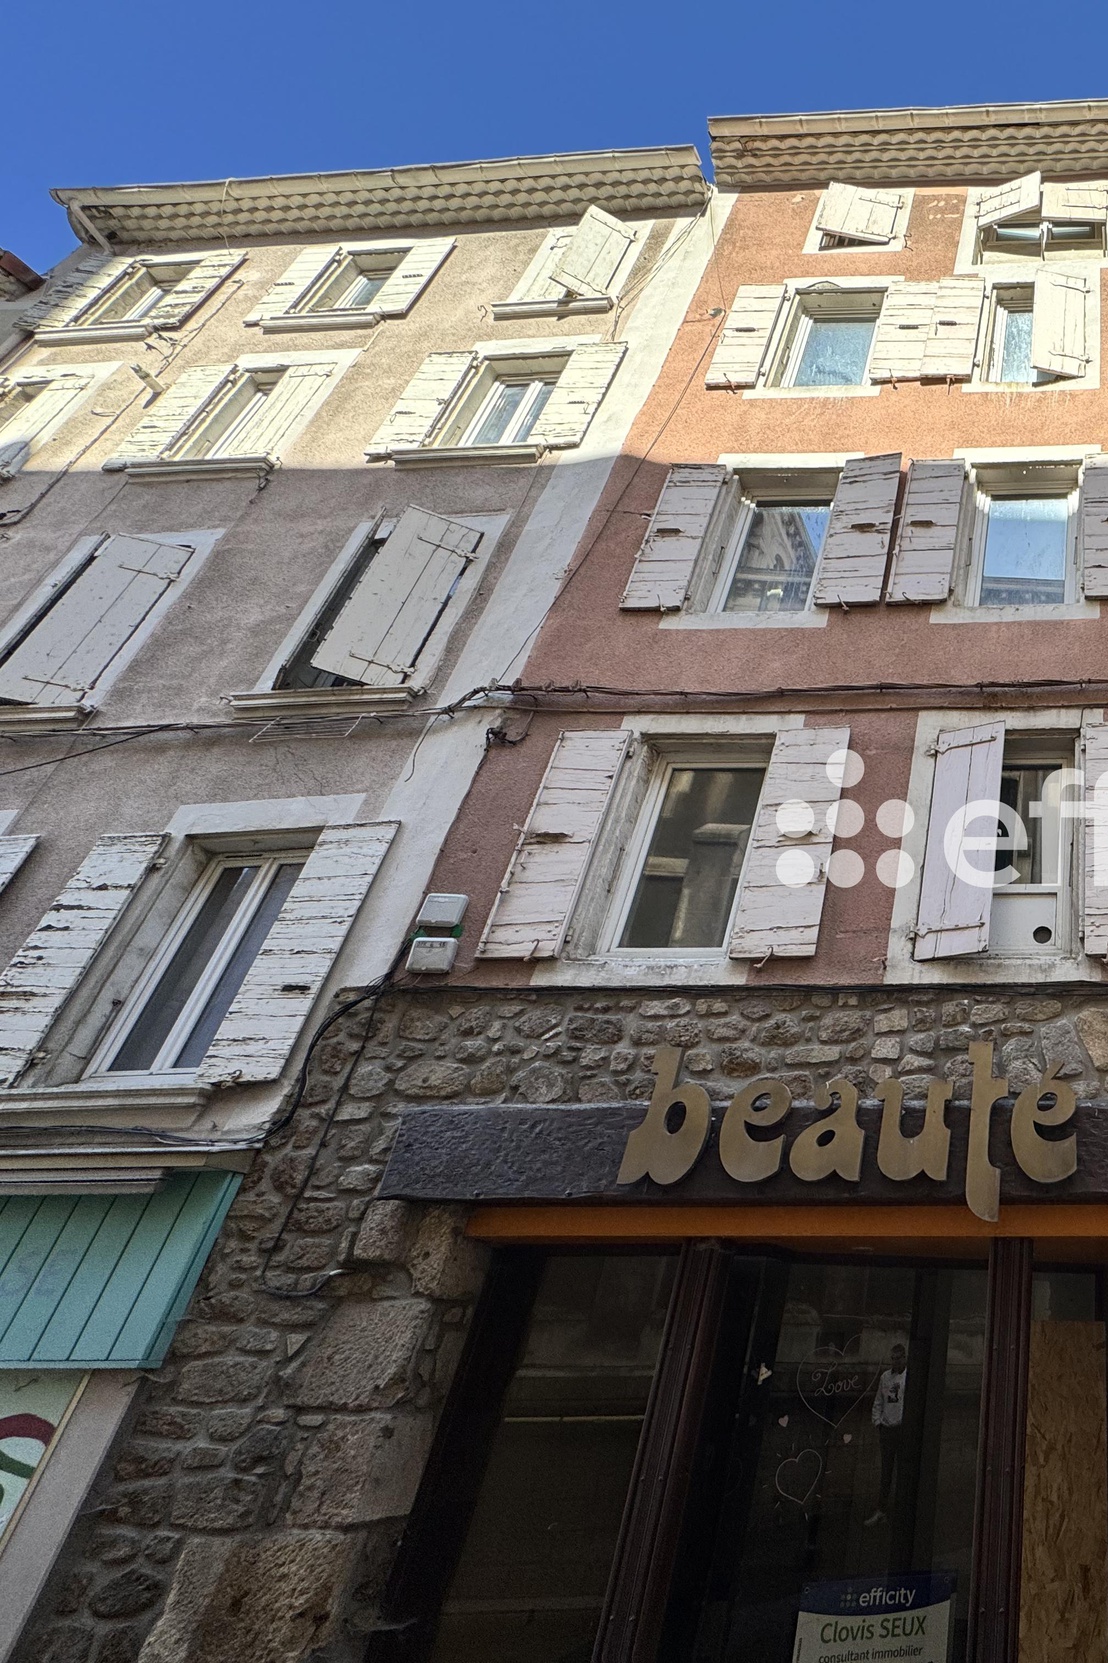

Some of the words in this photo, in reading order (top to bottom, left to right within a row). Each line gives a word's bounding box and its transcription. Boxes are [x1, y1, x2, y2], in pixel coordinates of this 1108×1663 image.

[616, 1041, 1078, 1222] beauté
[811, 1360, 862, 1396] Love
[858, 1587, 917, 1607] efficity
[820, 1618, 875, 1644] Clovis
[879, 1615, 927, 1639] SEUX
[818, 1648, 870, 1663] consultant
[871, 1645, 923, 1661] immobilier
